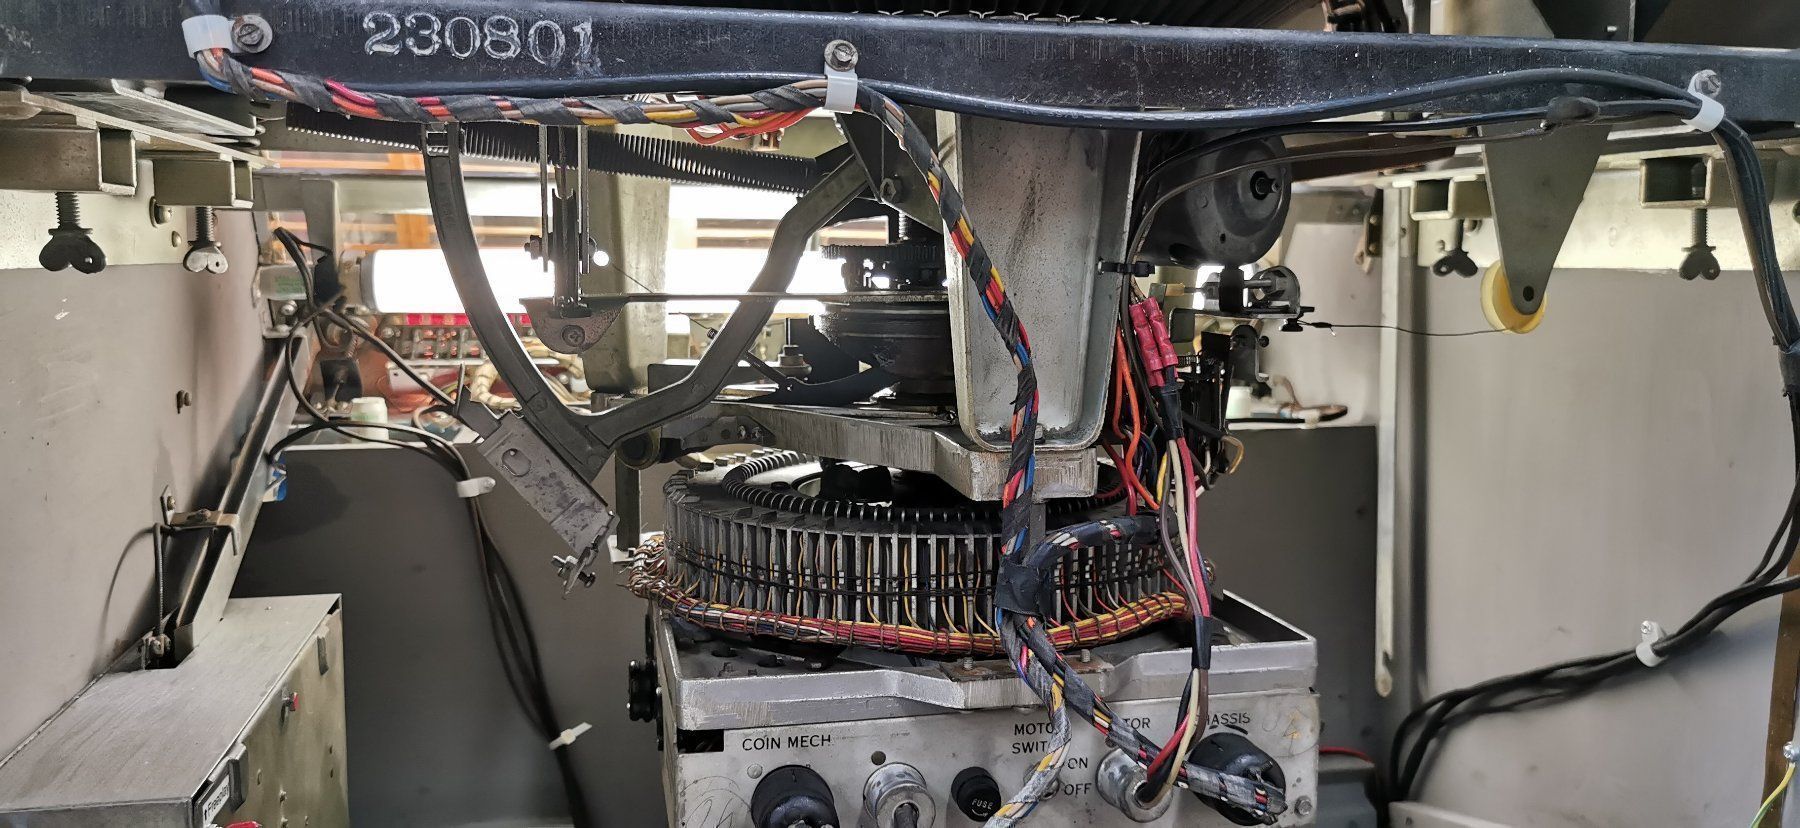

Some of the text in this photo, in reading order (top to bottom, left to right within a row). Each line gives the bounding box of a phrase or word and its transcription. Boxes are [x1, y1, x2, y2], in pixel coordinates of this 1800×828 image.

[362, 10, 601, 71] 230801
[1014, 722, 1055, 736] MOTO
[742, 734, 831, 751] COIN MECH
[1012, 740, 1048, 754] SWIT
[1067, 757, 1088, 770] ON
[1064, 782, 1092, 796] OFF
[971, 798, 994, 810] FUSE
